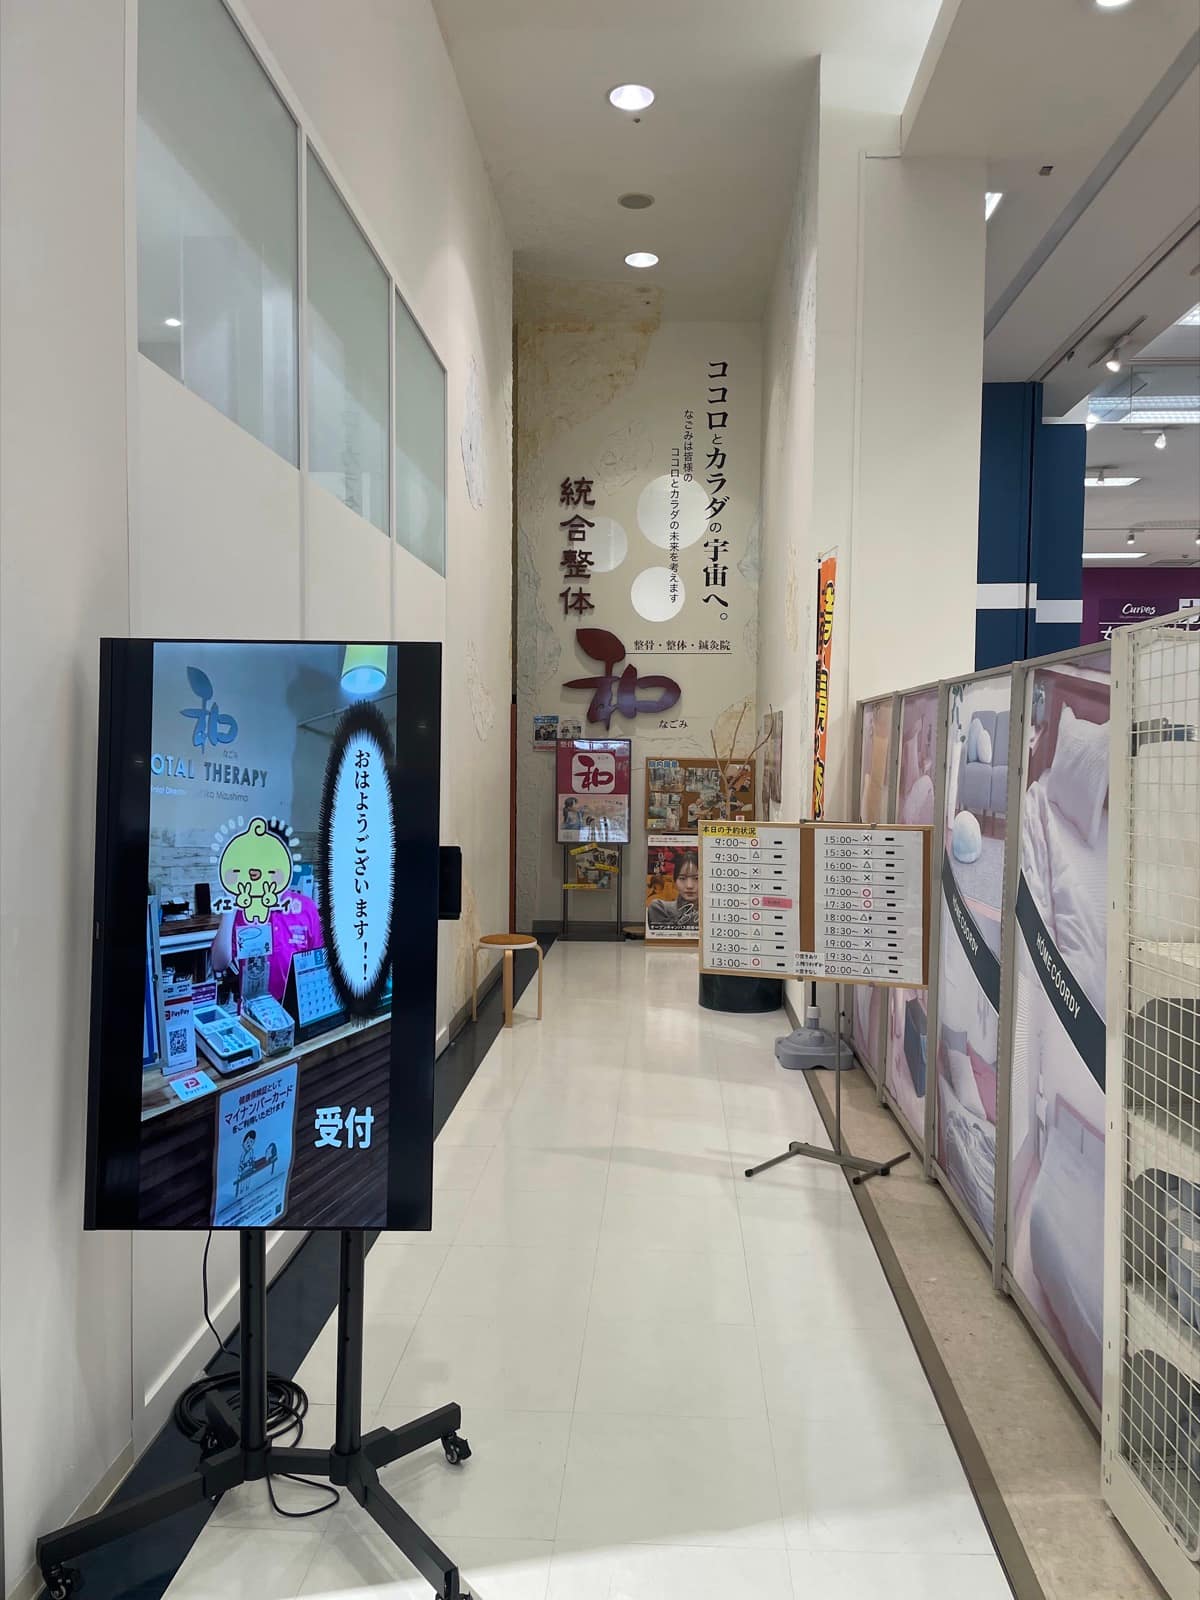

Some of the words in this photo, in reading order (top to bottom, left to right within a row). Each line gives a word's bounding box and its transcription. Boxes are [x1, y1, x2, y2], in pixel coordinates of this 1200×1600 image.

[683, 408, 694, 483] なごみは皆様の
[702, 360, 730, 621] ココロとカラダの宇宙へ。
[559, 475, 596, 615] 統合整体
[669, 447, 680, 604] ココロとカラダの未来を考えます
[1121, 603, 1156, 615] Curves
[633, 639, 731, 651] 整骨・整体・鍼灸院
[658, 719, 689, 729] なごみ
[203, 761, 268, 788] THERAPY
[314, 1106, 375, 1149] 受付
